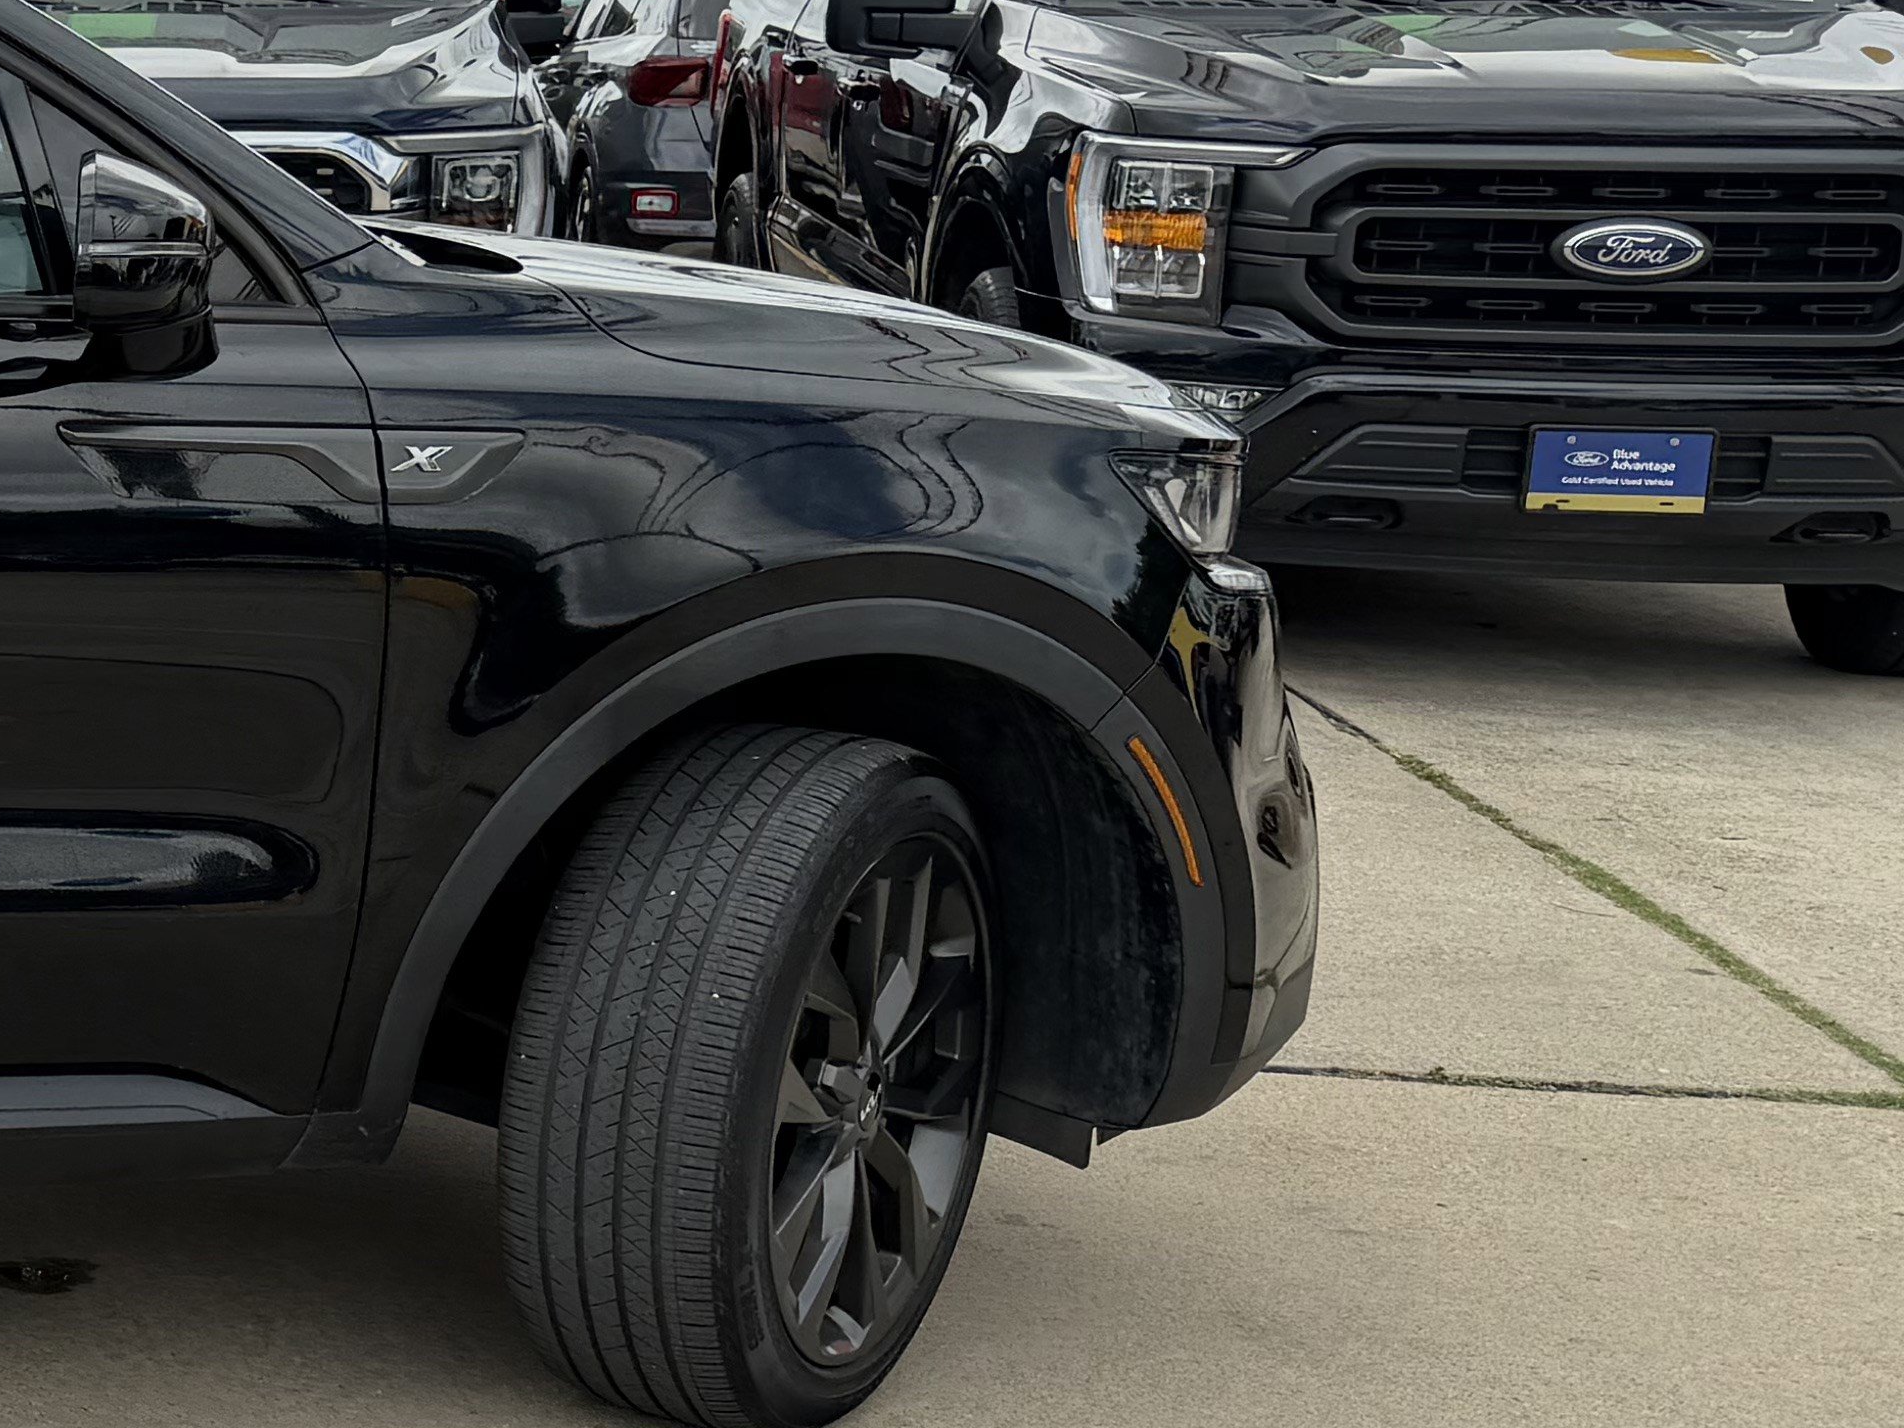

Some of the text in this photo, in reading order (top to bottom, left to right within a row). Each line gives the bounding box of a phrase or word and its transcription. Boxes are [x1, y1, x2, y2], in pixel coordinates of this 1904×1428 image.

[1597, 234, 1673, 264] Ford
[1613, 448, 1640, 459] Blue
[1611, 460, 1676, 473] Advantage
[1620, 478, 1642, 486] Used
